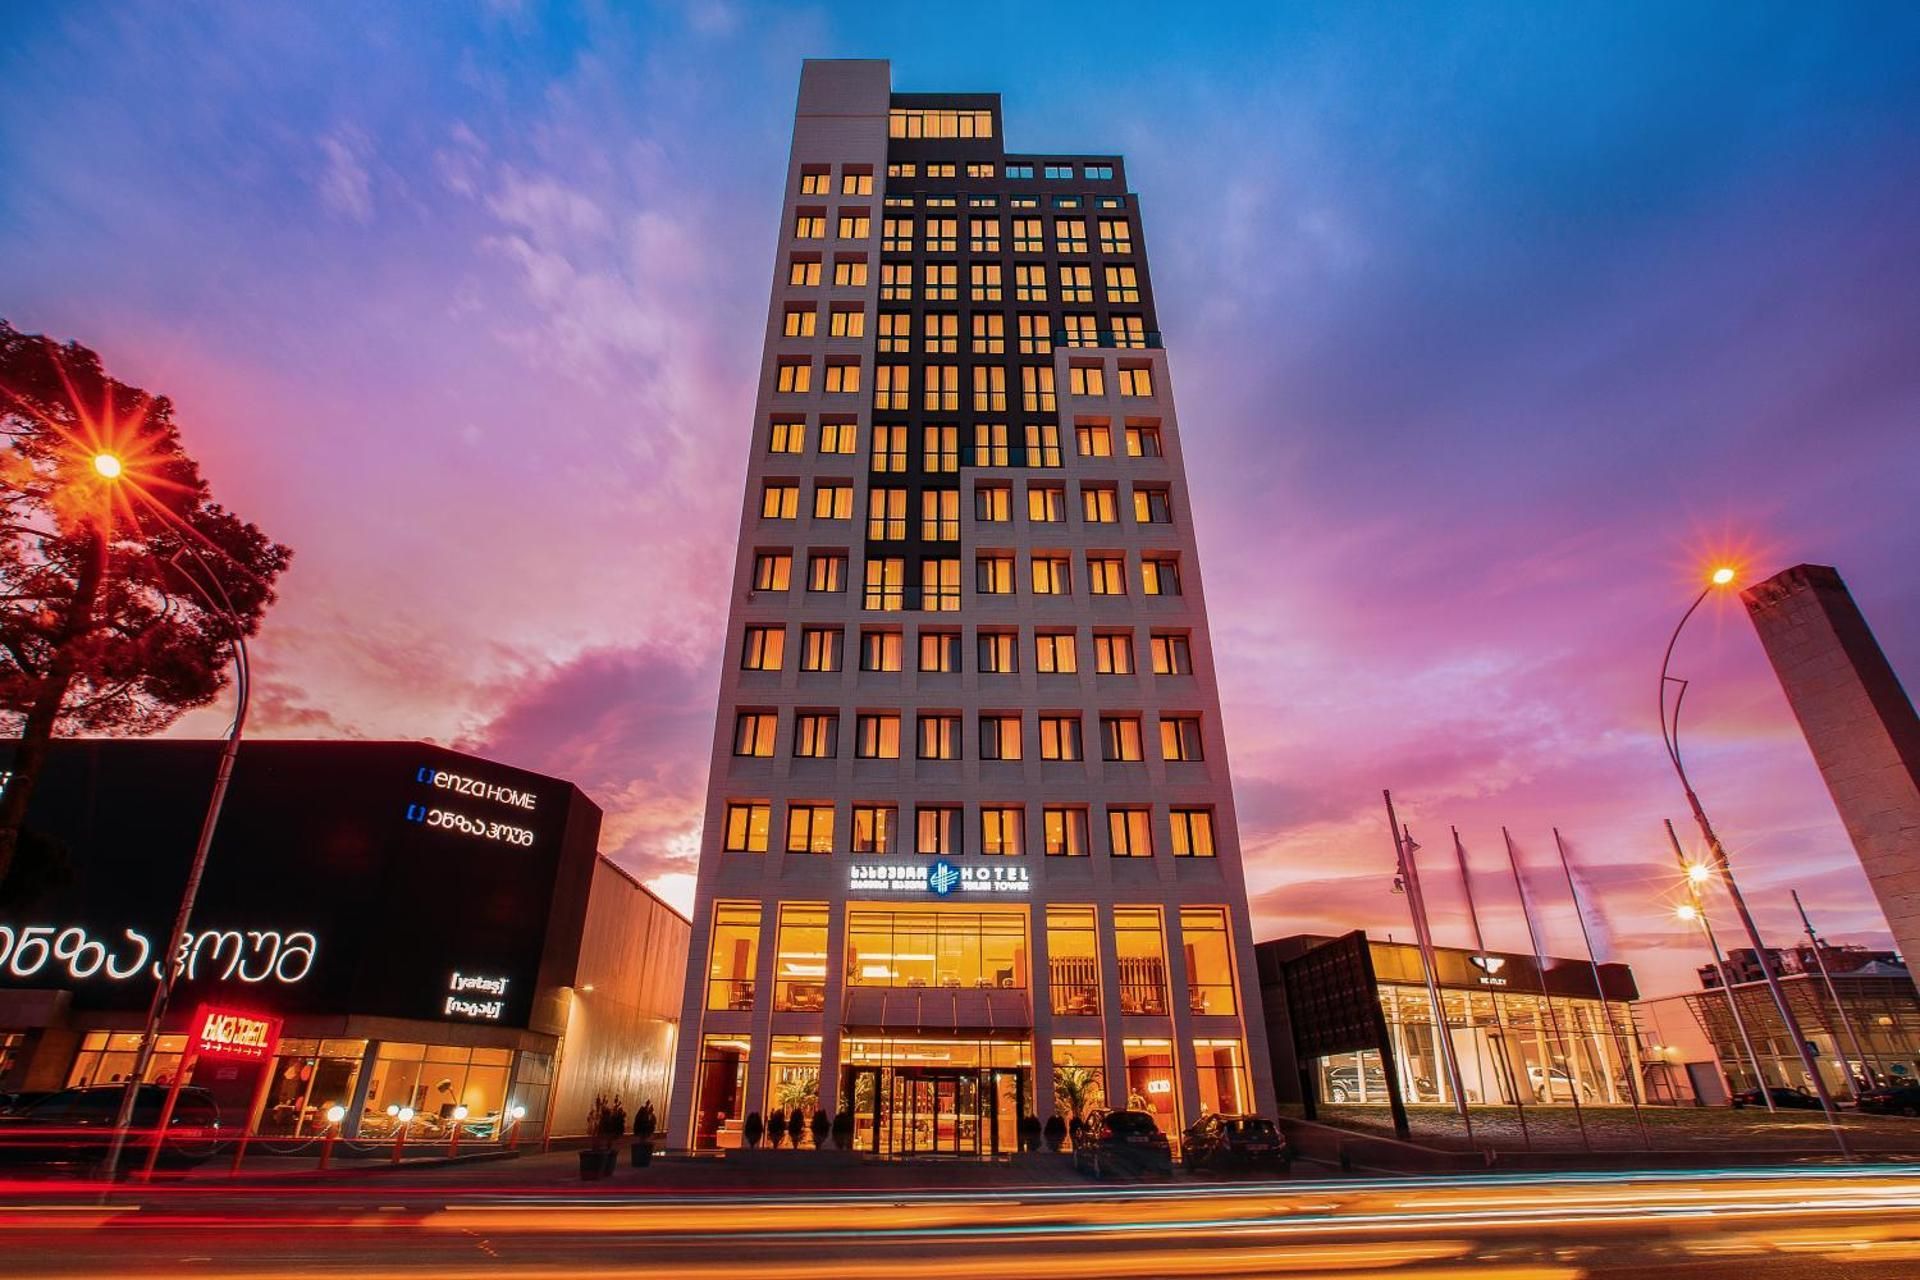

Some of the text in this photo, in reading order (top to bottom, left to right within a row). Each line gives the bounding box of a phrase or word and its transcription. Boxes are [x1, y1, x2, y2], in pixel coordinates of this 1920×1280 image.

[433, 771, 537, 810] enza HOME
[426, 808, 534, 846] ენზა ჰოუმ
[961, 867, 1029, 881] HOTEL
